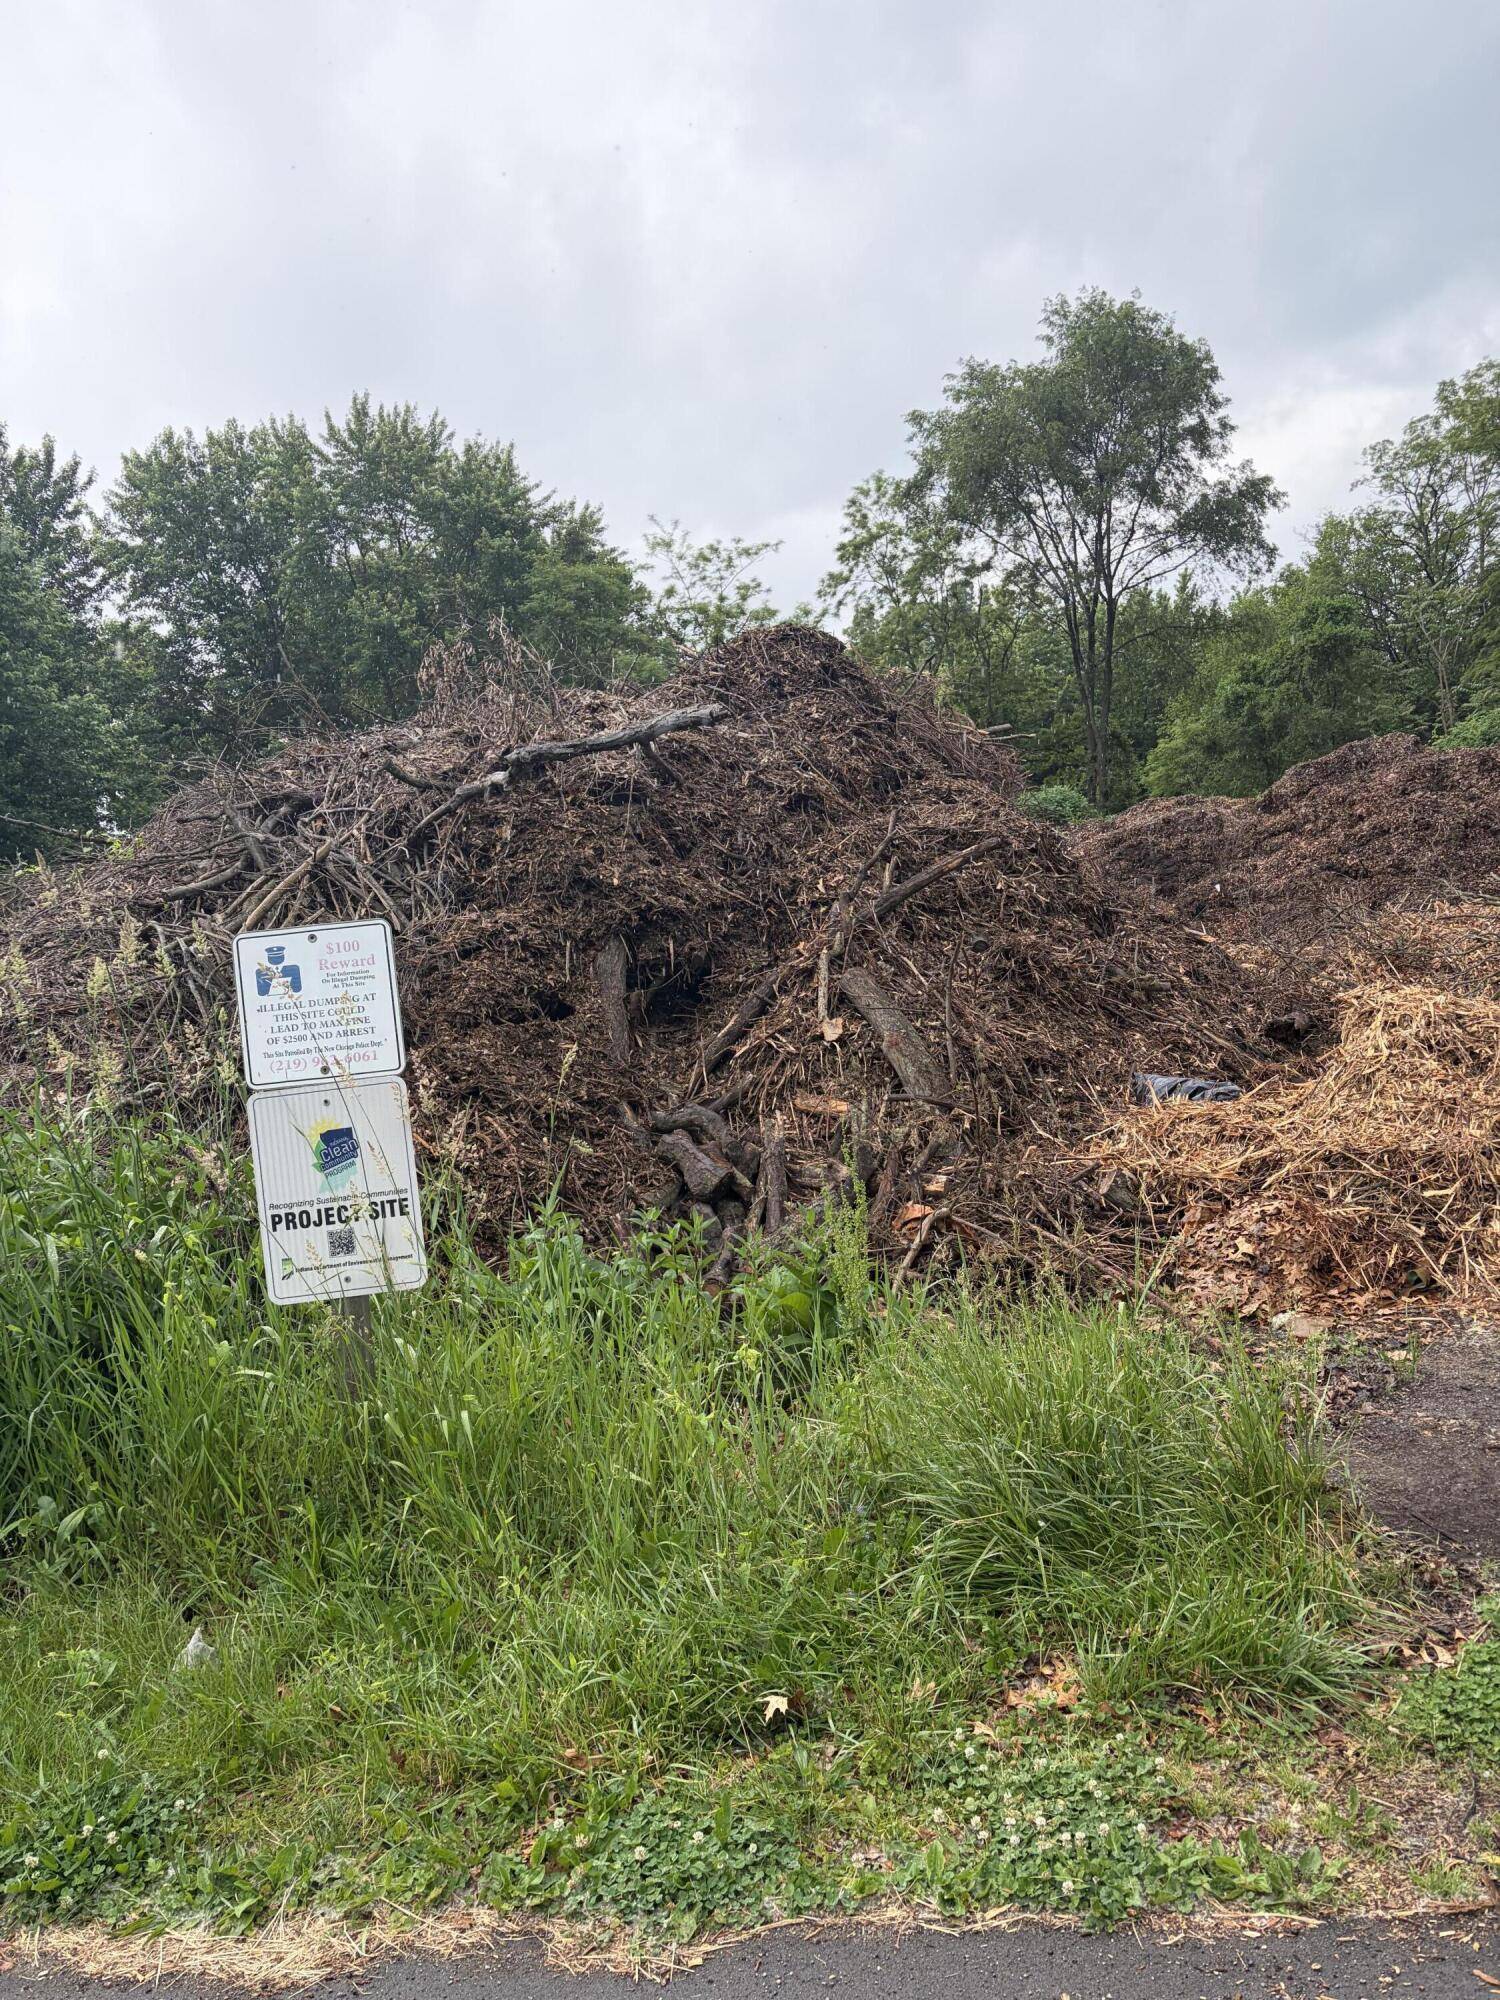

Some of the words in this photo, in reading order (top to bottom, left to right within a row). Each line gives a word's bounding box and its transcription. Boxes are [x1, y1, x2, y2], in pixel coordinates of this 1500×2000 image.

[326, 940, 360, 954] $100
[319, 953, 376, 970] Reward
[331, 976, 349, 984] Illegal
[350, 974, 376, 982] Dumping
[337, 969, 370, 977] Information
[259, 1002, 306, 1013] ILLEGAL
[362, 992, 377, 1002] AT
[273, 1012, 299, 1022] THIS
[301, 1009, 325, 1019] SITE
[327, 1005, 365, 1017] COULD
[270, 1024, 299, 1034] LEAD
[301, 1022, 317, 1031] TO
[319, 1019, 343, 1029] MAX
[345, 1016, 371, 1026] FINE
[266, 1037, 280, 1046] OF
[282, 1034, 308, 1044] $2500
[310, 1031, 333, 1041] AND
[335, 1026, 376, 1038] ARREST
[306, 1047, 313, 1055] By
[355, 1041, 370, 1049] Police
[270, 1057, 307, 1073] (219)
[312, 1050, 378, 1067] 92-6061
[320, 1139, 356, 1162] Clean
[268, 1199, 314, 1211] Recognizing
[316, 1194, 359, 1205] Sustanabe
[270, 1203, 360, 1232] PROJECT
[368, 1197, 410, 1221] SITE
[313, 1262, 342, 1271] Deartment
[382, 1254, 413, 1262] nagement
